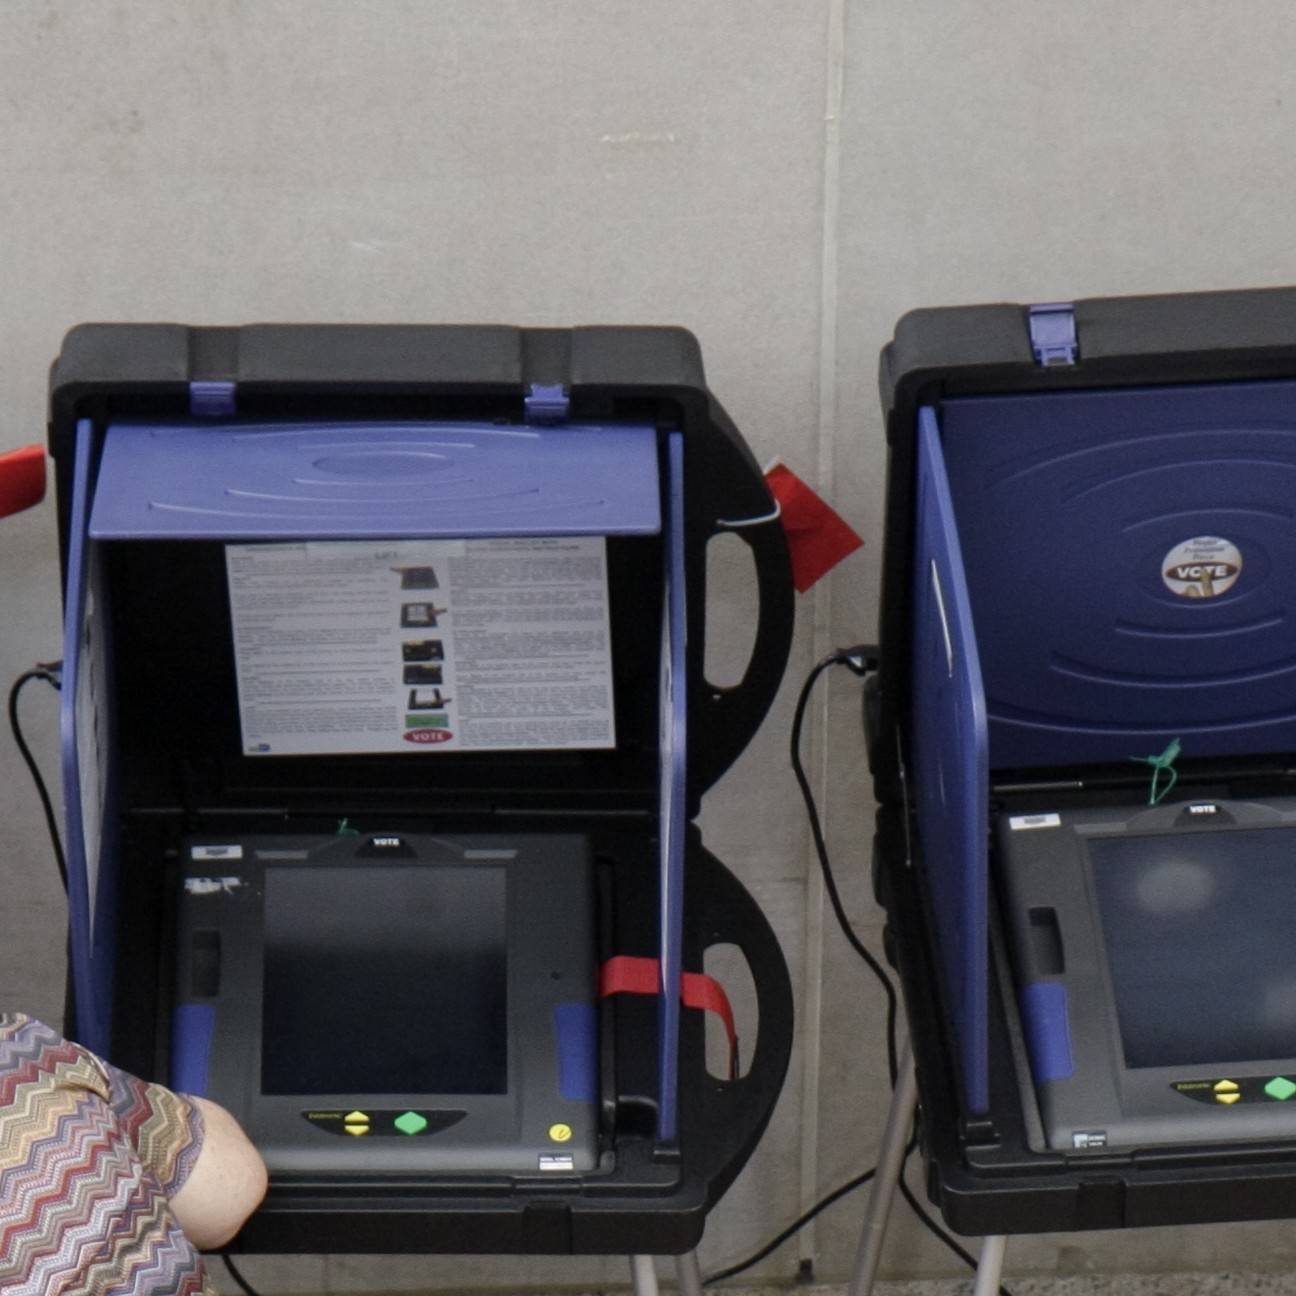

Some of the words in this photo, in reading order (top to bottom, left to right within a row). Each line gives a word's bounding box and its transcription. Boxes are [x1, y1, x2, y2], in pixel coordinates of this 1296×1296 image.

[412, 731, 445, 741] VOTE
[1189, 804, 1216, 814] VOTE
[373, 837, 400, 846] VOTE
